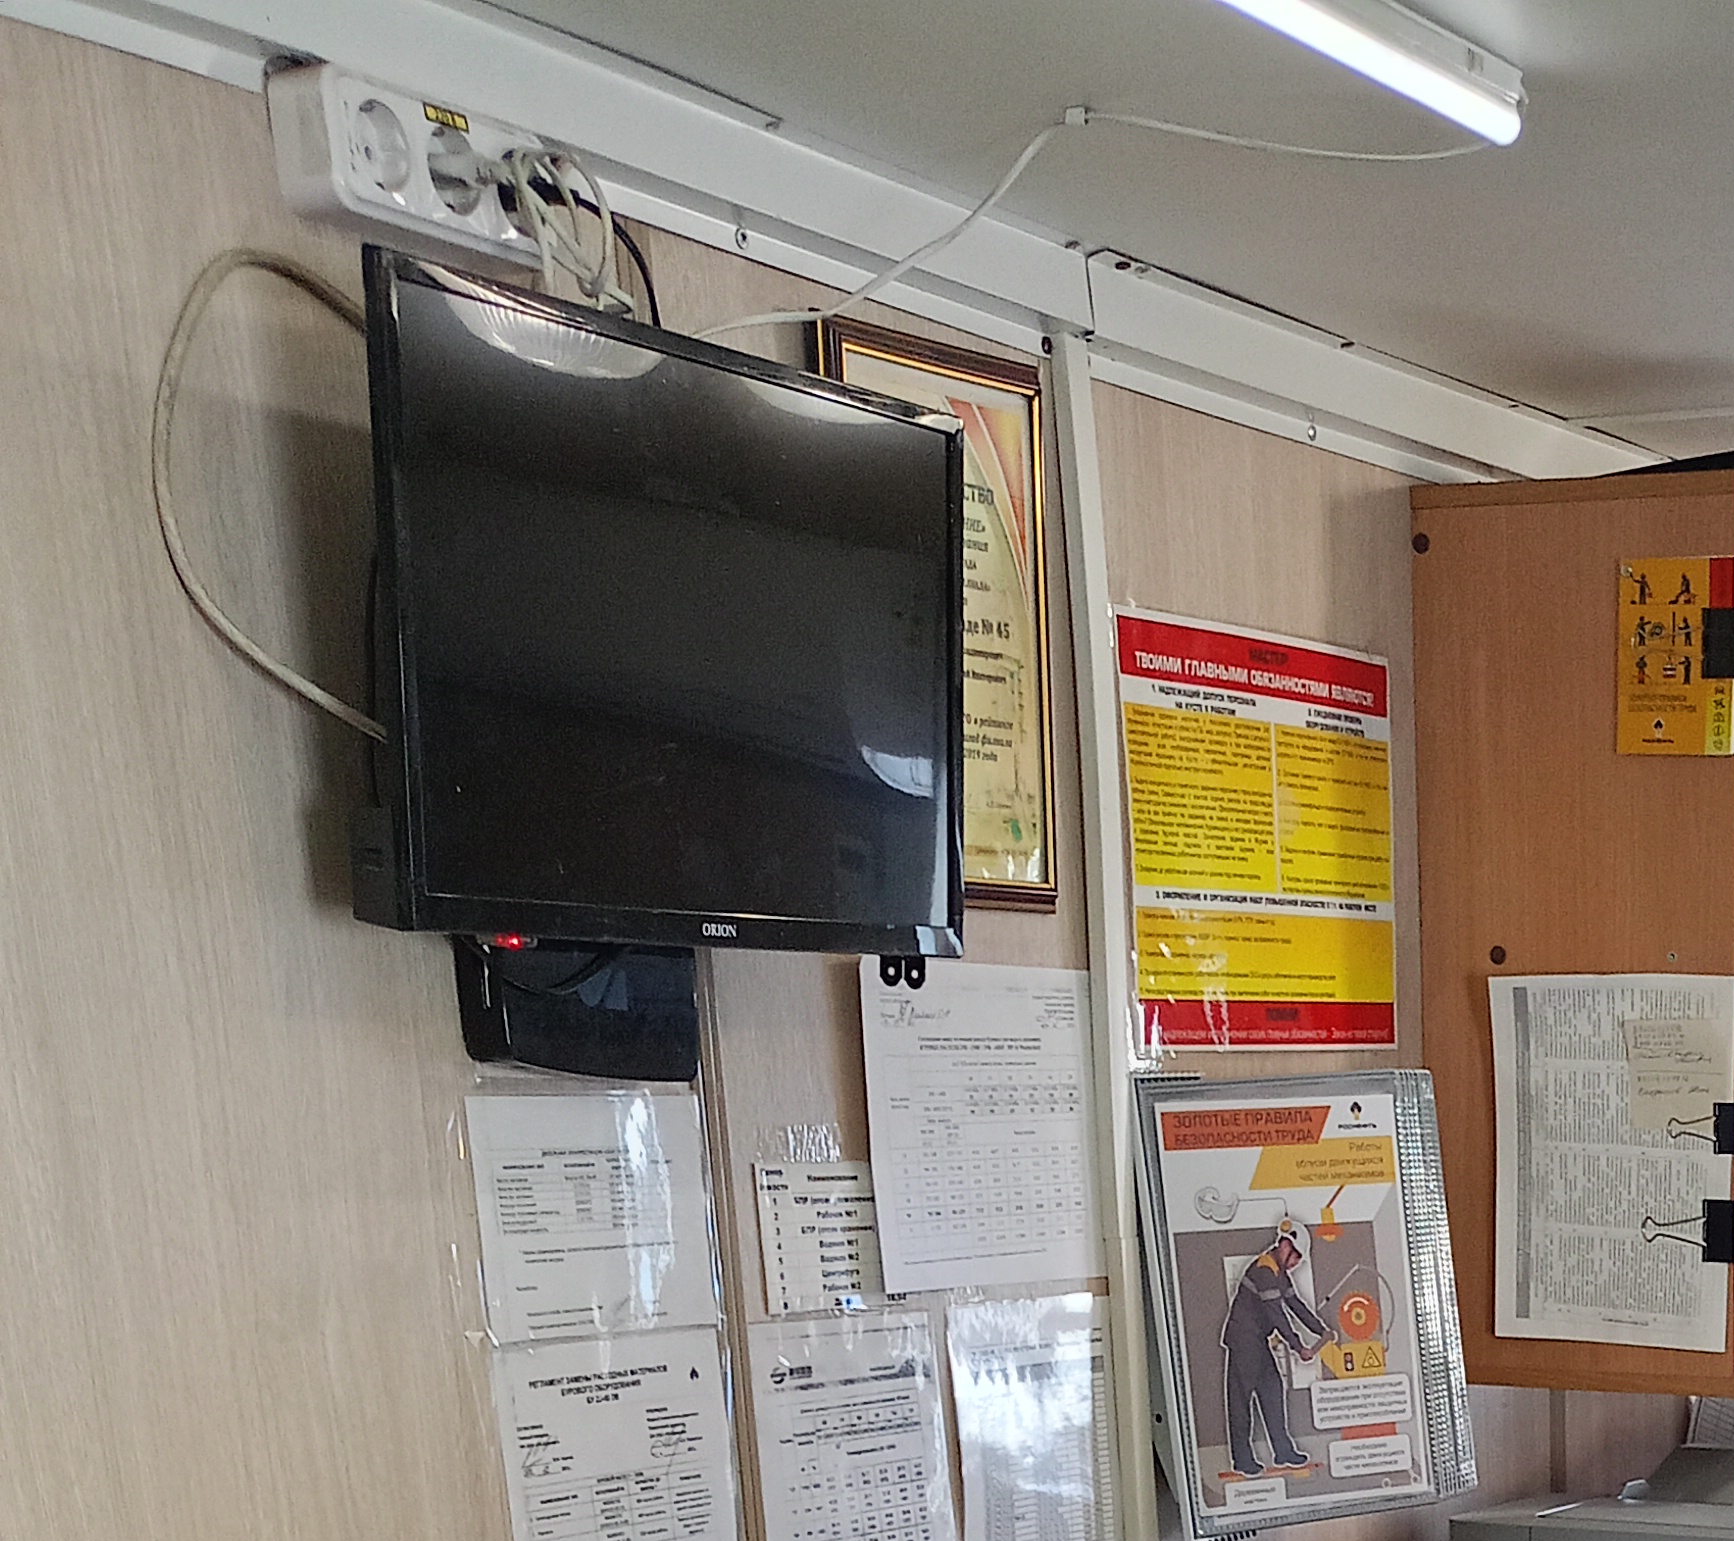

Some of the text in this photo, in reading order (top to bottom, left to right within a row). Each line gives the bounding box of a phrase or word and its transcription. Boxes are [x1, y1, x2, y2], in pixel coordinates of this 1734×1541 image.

[996, 621, 1010, 639] 45
[1135, 651, 1182, 673] ТВОИМИ
[1184, 658, 1248, 684] ГЛАВНЫМИ
[702, 922, 737, 937] ORION
[1173, 1110, 1313, 1129] ЗОЛОТЫЕ ПРАВИЛА
[1174, 1129, 1314, 1146] БЕЗОПАСНОСТИ ТРУДА
